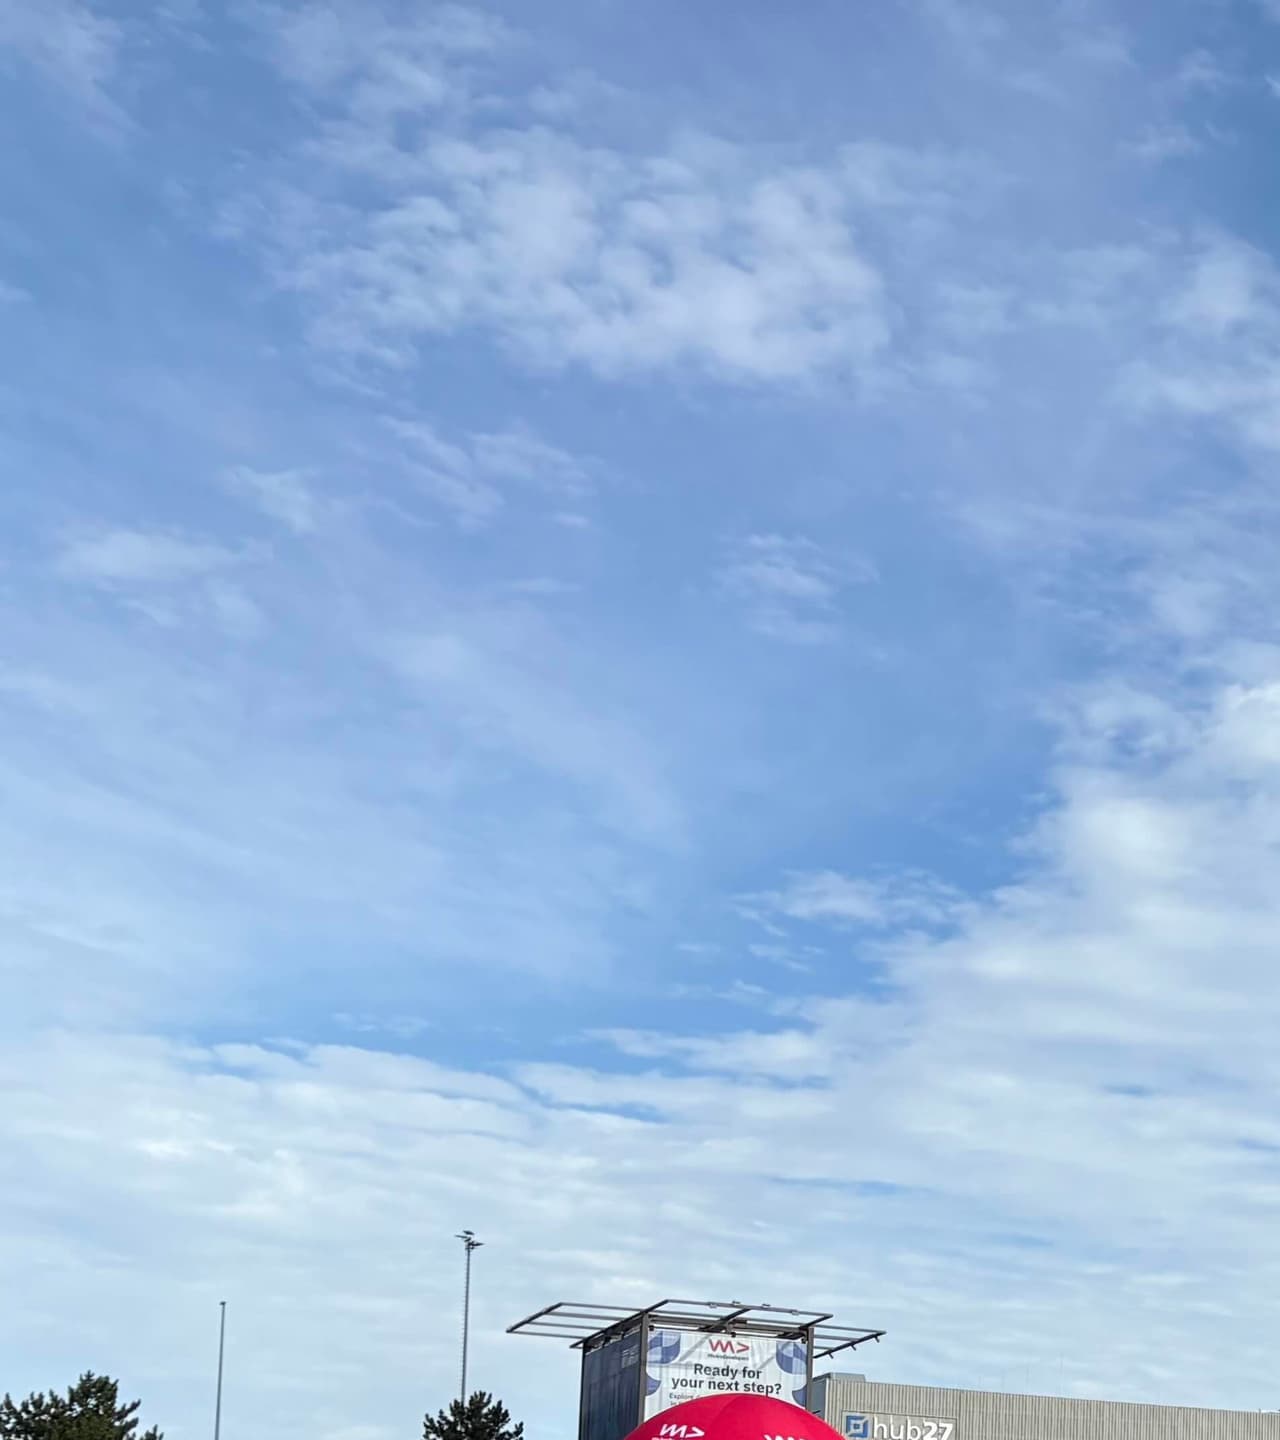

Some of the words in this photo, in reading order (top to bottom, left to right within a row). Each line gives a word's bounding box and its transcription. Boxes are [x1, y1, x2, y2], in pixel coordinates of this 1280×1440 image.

[694, 1363, 739, 1380] Ready
[742, 1366, 762, 1379] for
[671, 1377, 705, 1389] your
[708, 1379, 740, 1391] next
[743, 1382, 782, 1395] step?
